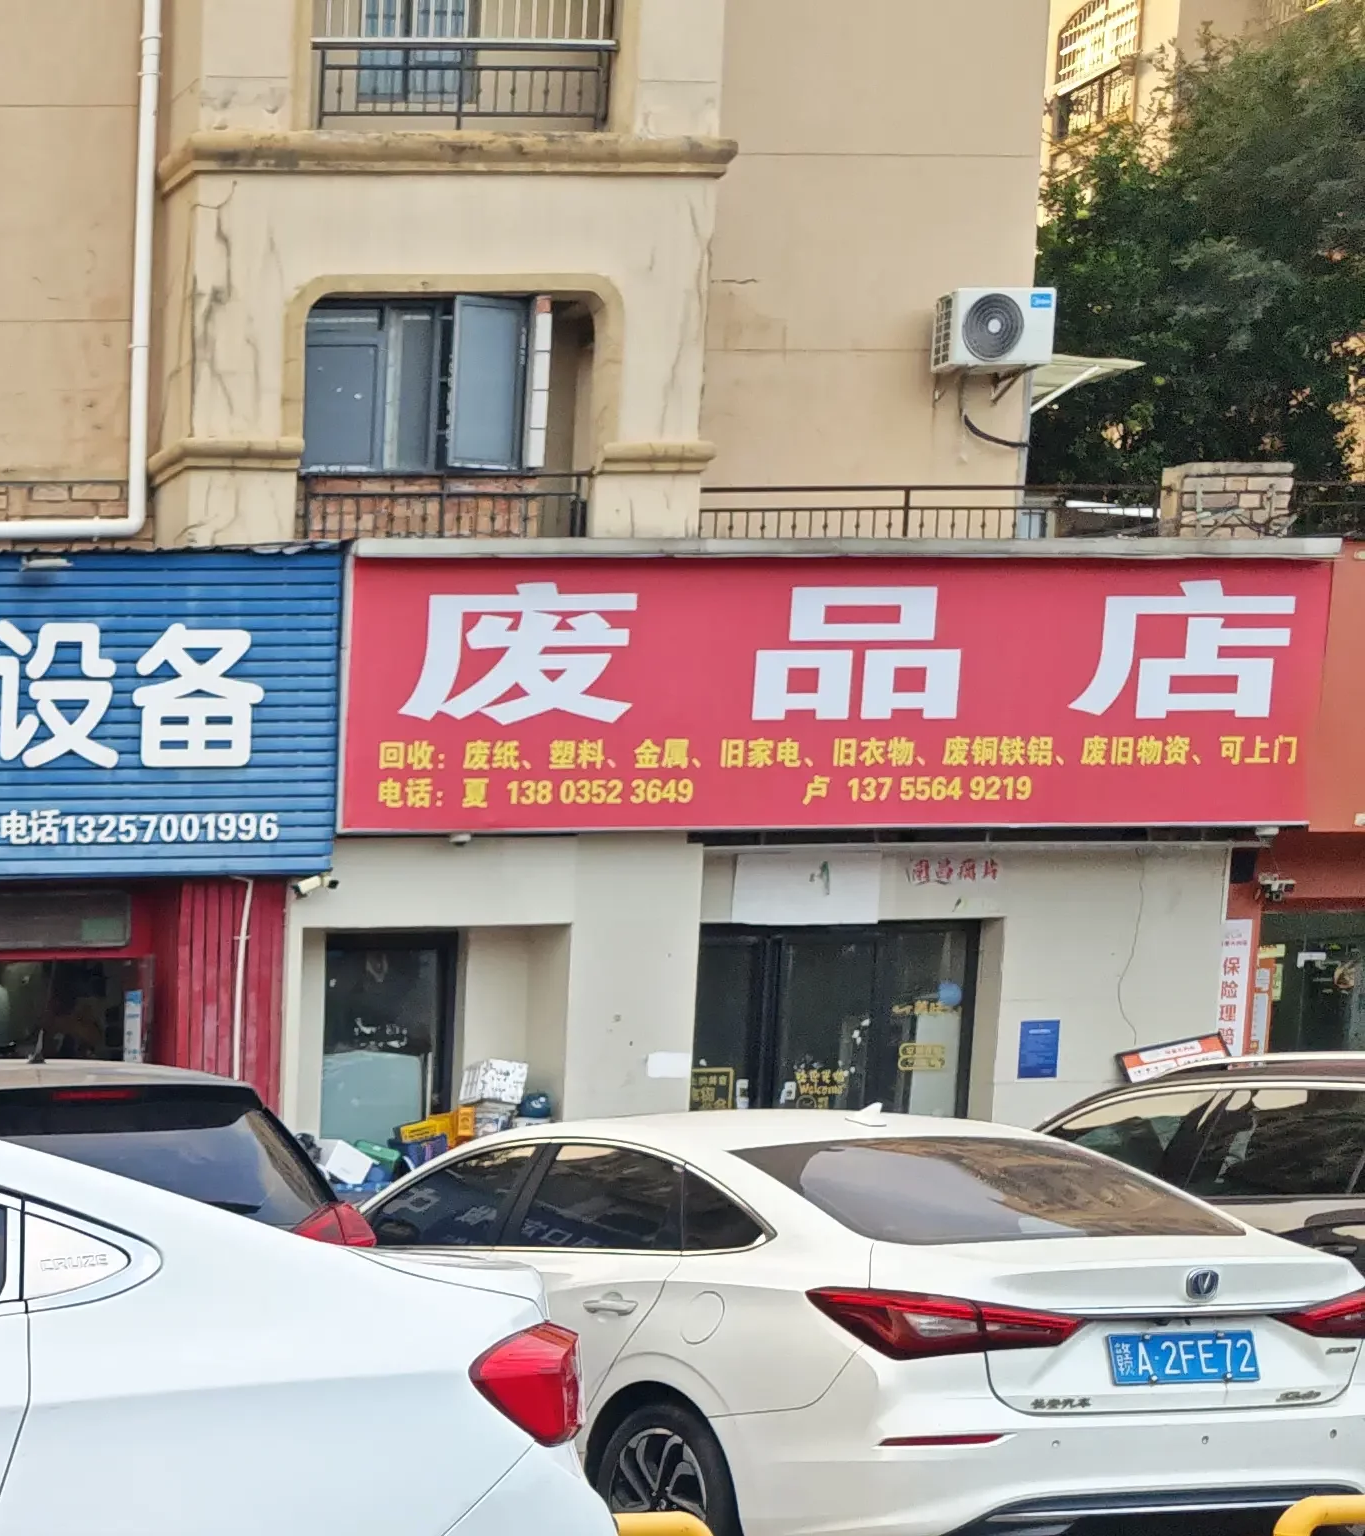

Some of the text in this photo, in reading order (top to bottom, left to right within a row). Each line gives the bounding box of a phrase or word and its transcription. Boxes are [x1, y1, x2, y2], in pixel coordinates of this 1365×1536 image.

[506, 779, 554, 806] 138
[559, 779, 624, 806] 0352
[629, 778, 695, 804] 3649
[803, 775, 1033, 804] 卢 137 5564 9219
[40, 1253, 108, 1271] CRUZE
